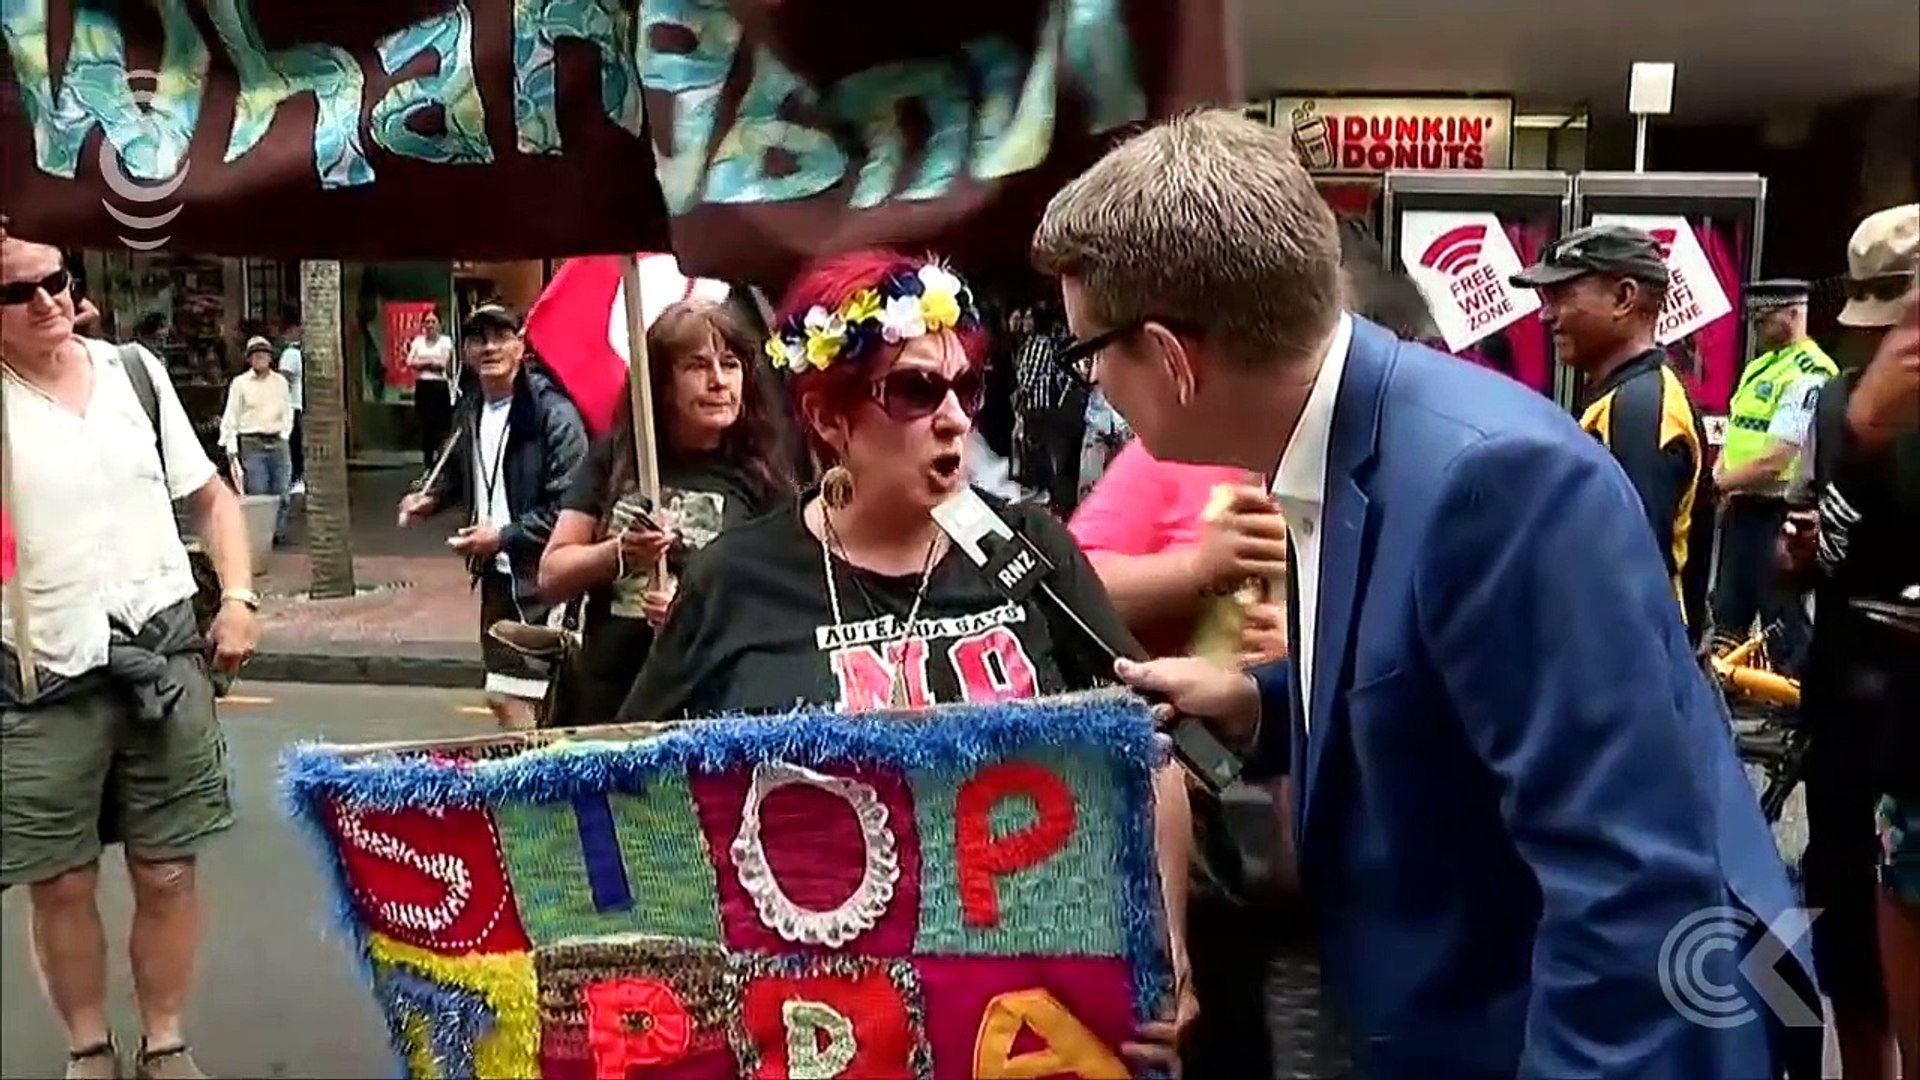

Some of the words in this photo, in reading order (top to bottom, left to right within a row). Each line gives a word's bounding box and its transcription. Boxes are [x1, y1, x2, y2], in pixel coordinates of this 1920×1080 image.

[1343, 115, 1493, 143] DUNKIN'
[1343, 143, 1484, 170] DONUTS
[1449, 263, 1497, 298] FREE
[1467, 297, 1514, 331] ZONE
[1653, 302, 1703, 336] ZONE
[997, 549, 1037, 589] RNZ
[830, 625, 1040, 712] NO
[332, 760, 1078, 948] STOP
